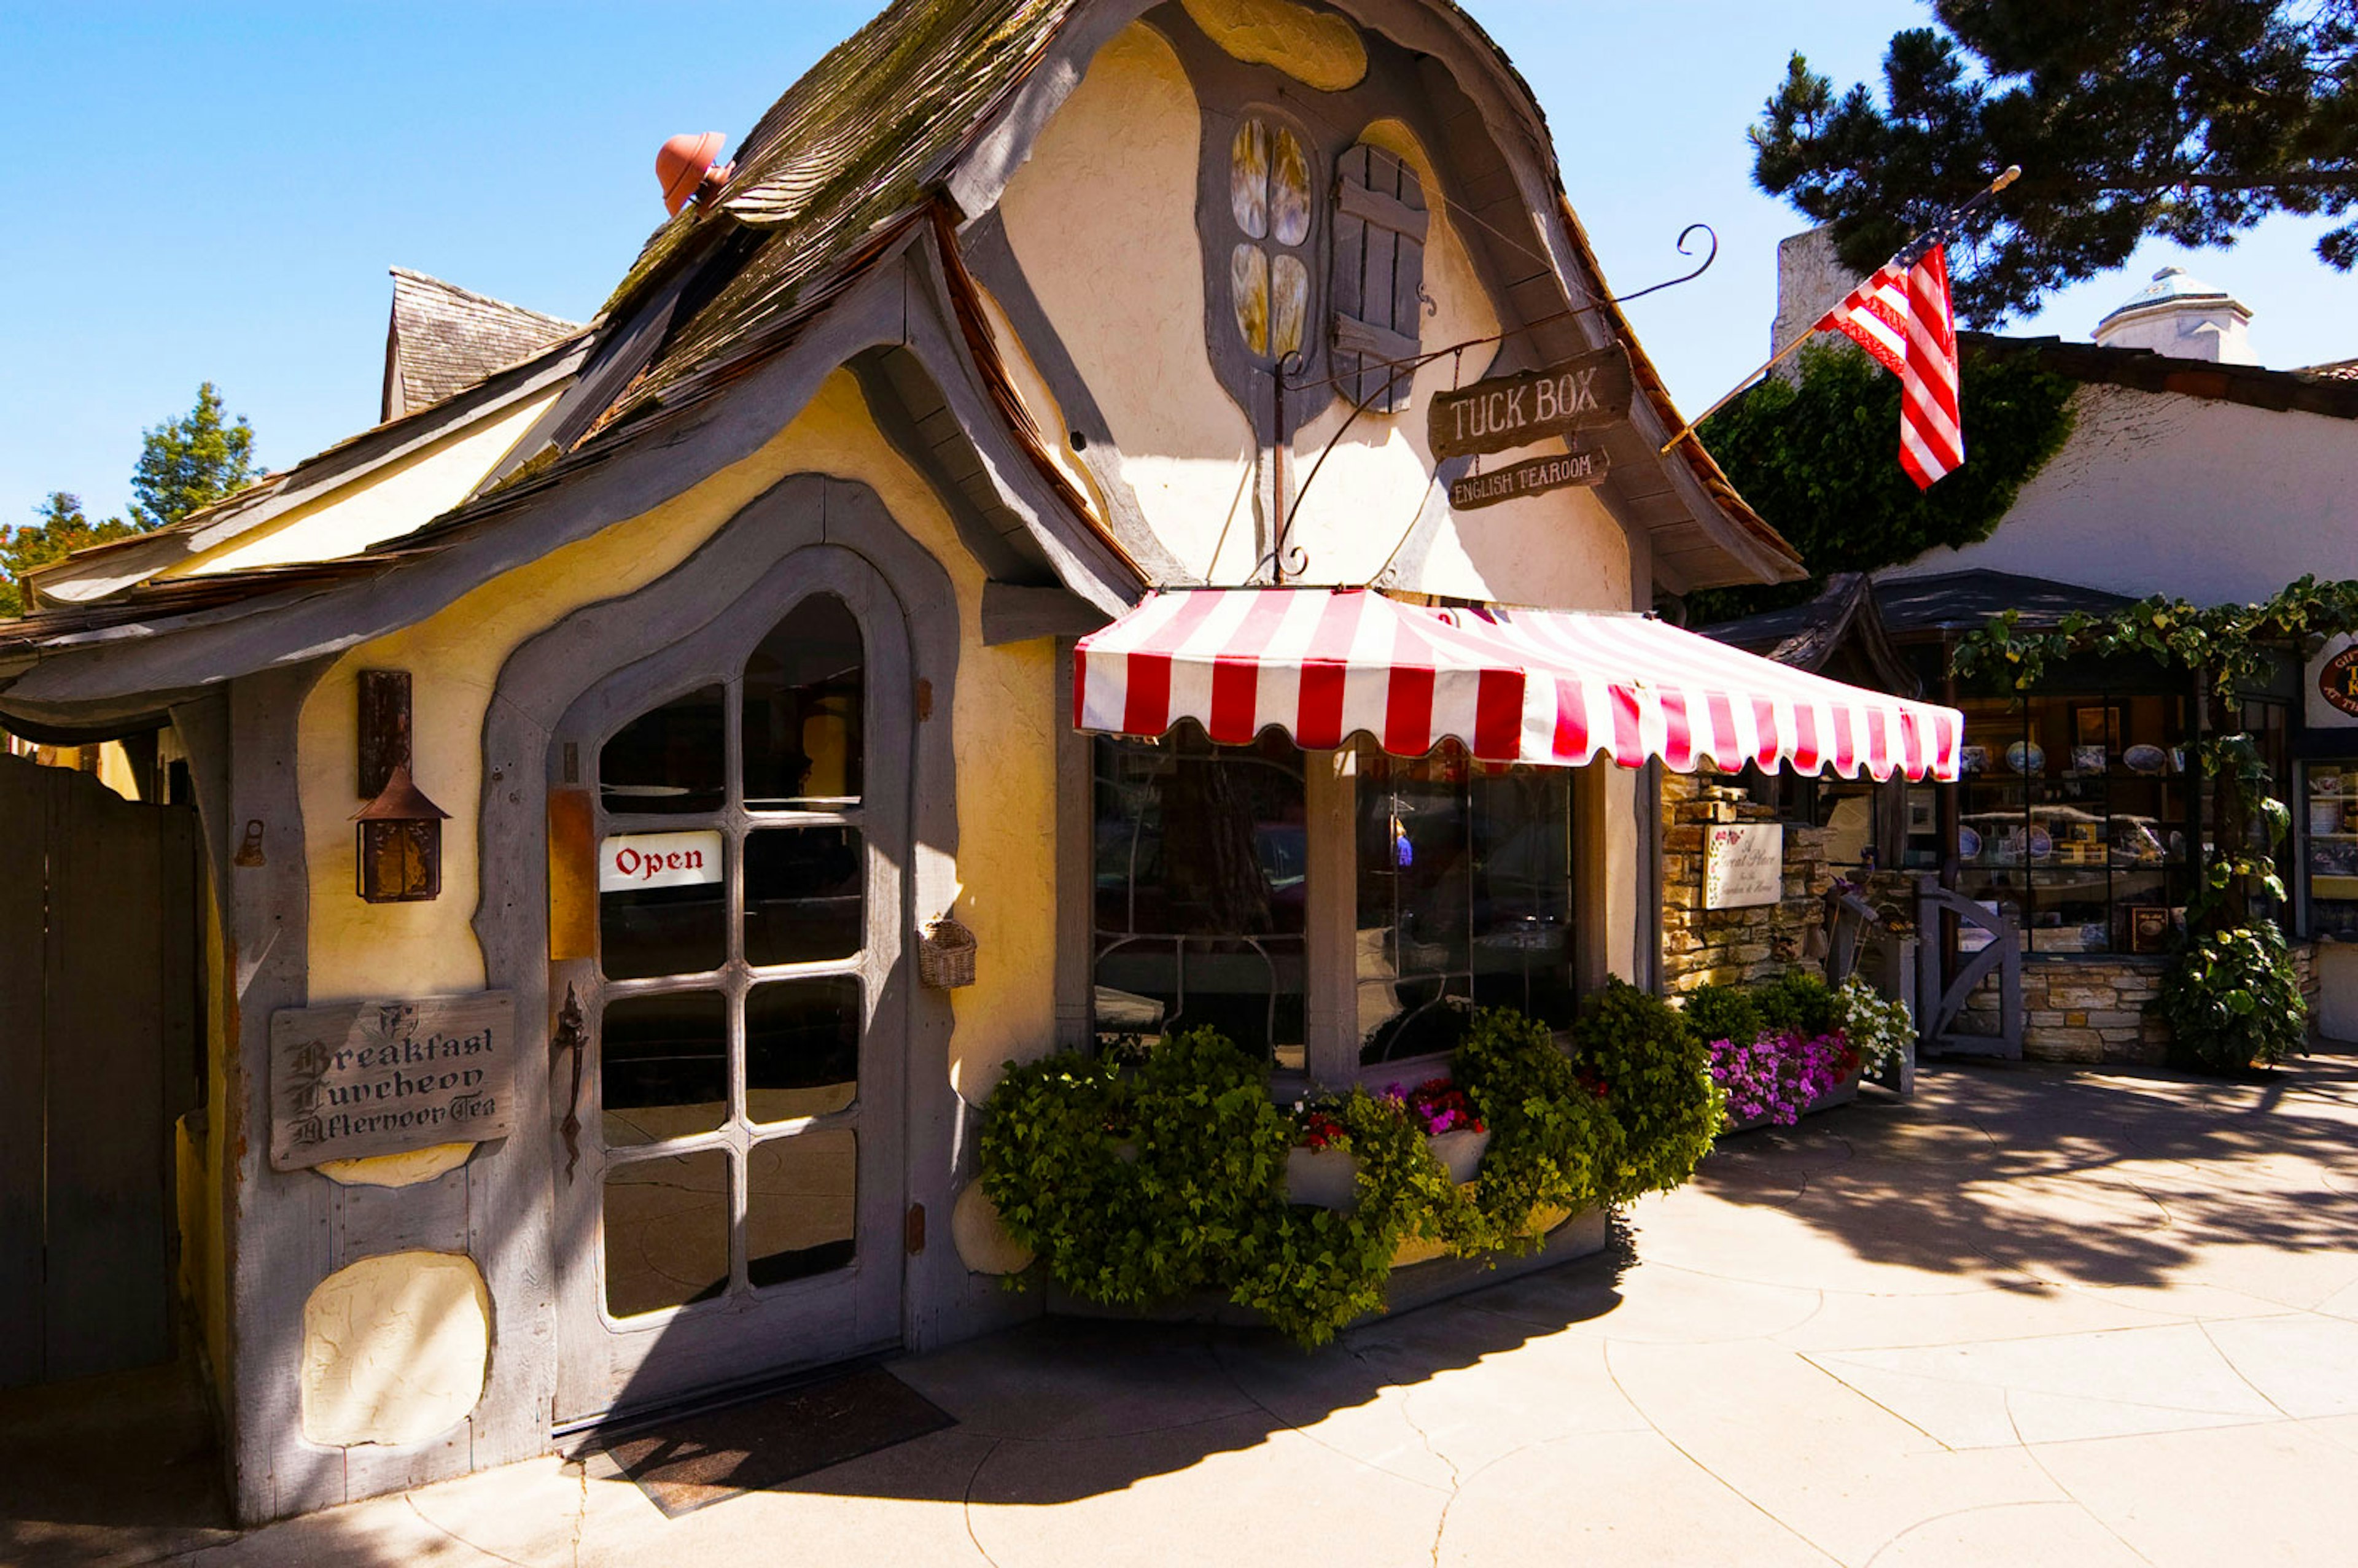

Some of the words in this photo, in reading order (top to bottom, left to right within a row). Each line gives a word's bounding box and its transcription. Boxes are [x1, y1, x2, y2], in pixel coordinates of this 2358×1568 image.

[1450, 386, 1527, 440] TUCK
[1535, 367, 1598, 422] BOX
[1455, 474, 1514, 504] ENGLISH
[1519, 455, 1593, 489] TEAROOM
[617, 848, 703, 880] Open
[284, 1028, 494, 1081] Breakfast
[286, 1068, 484, 1116] Luncheon
[286, 1106, 446, 1146] Afternoon
[449, 1091, 496, 1122] Tea
